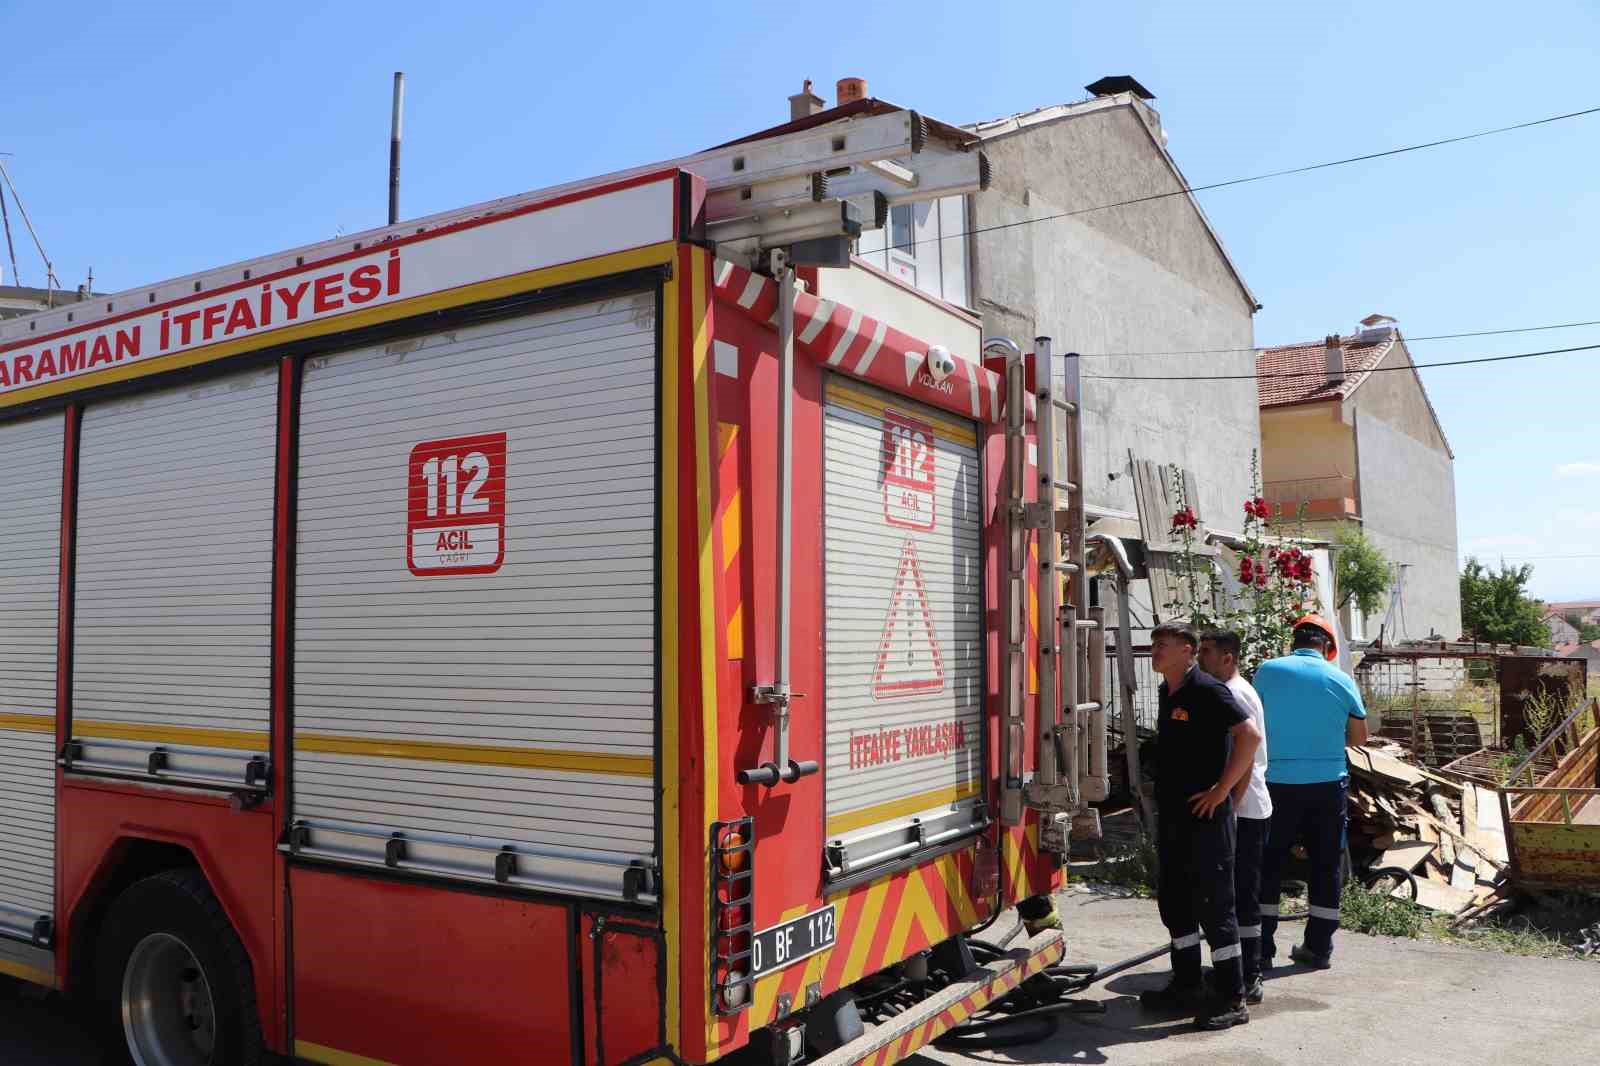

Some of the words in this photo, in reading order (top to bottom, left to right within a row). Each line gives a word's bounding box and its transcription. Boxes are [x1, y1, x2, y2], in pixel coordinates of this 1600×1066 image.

[159, 249, 401, 351] İTFAİYESİ
[893, 427, 928, 480] 112
[422, 452, 489, 517] 112
[775, 926, 794, 963] BF
[808, 912, 833, 947] 112
